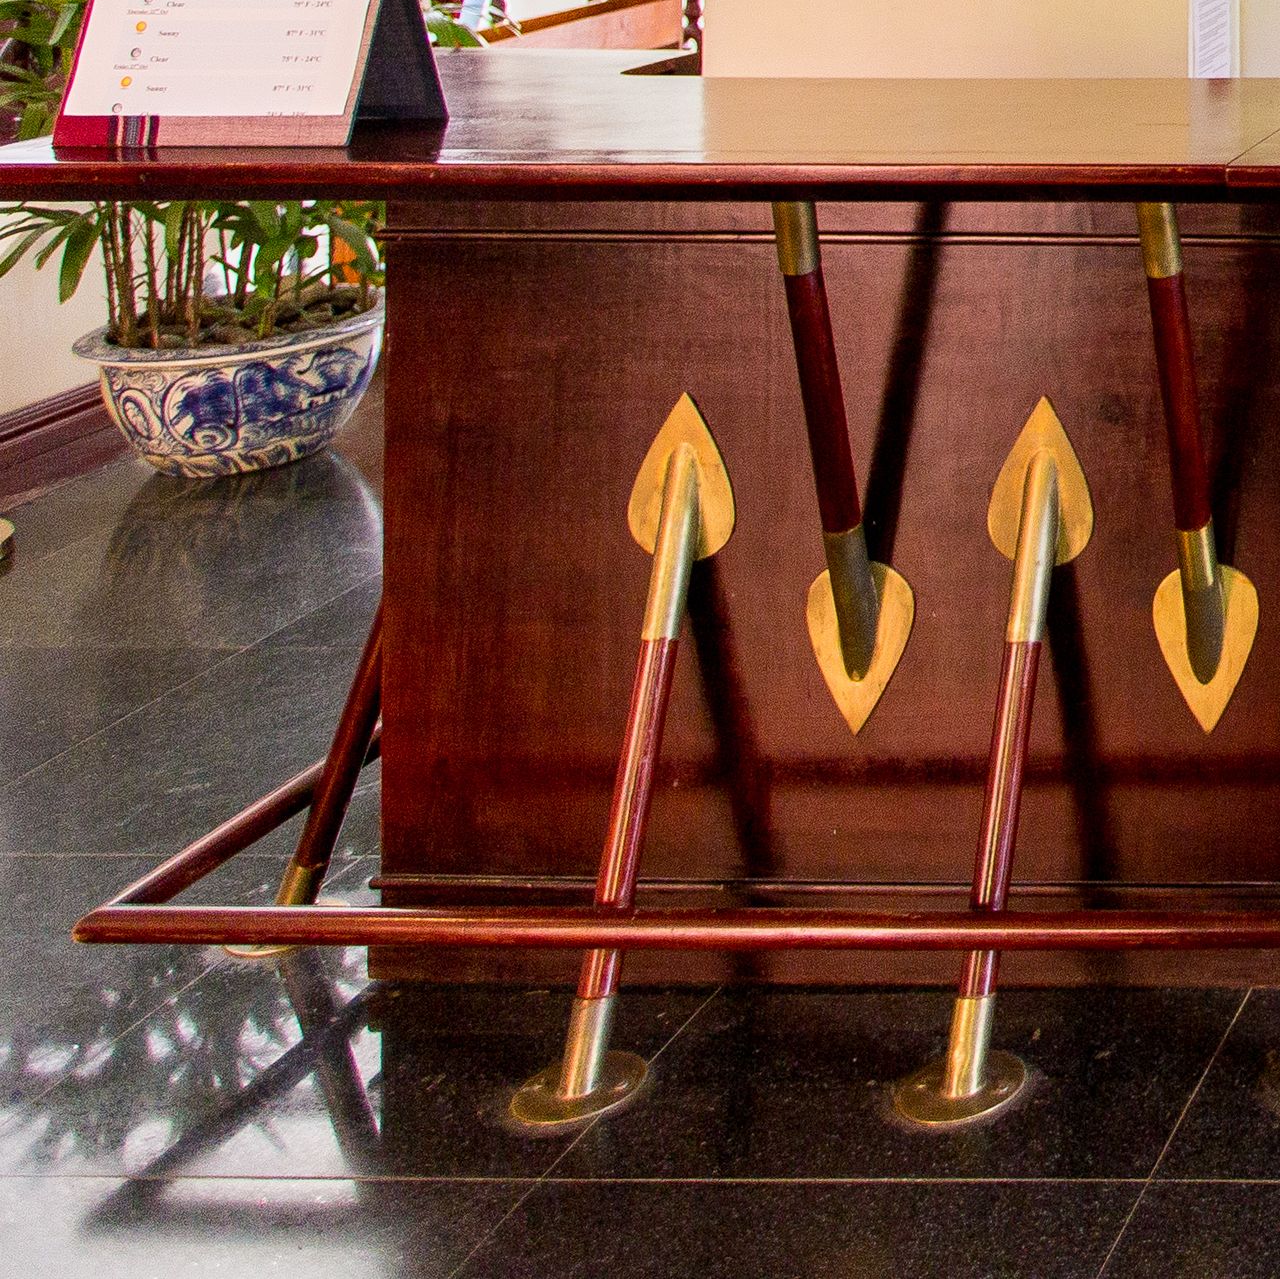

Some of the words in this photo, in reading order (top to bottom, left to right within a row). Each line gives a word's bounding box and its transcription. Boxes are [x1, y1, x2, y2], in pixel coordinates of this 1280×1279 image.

[159, 30, 179, 38] Sunny
[150, 55, 169, 63] Clear
[146, 85, 167, 93] Sunny
